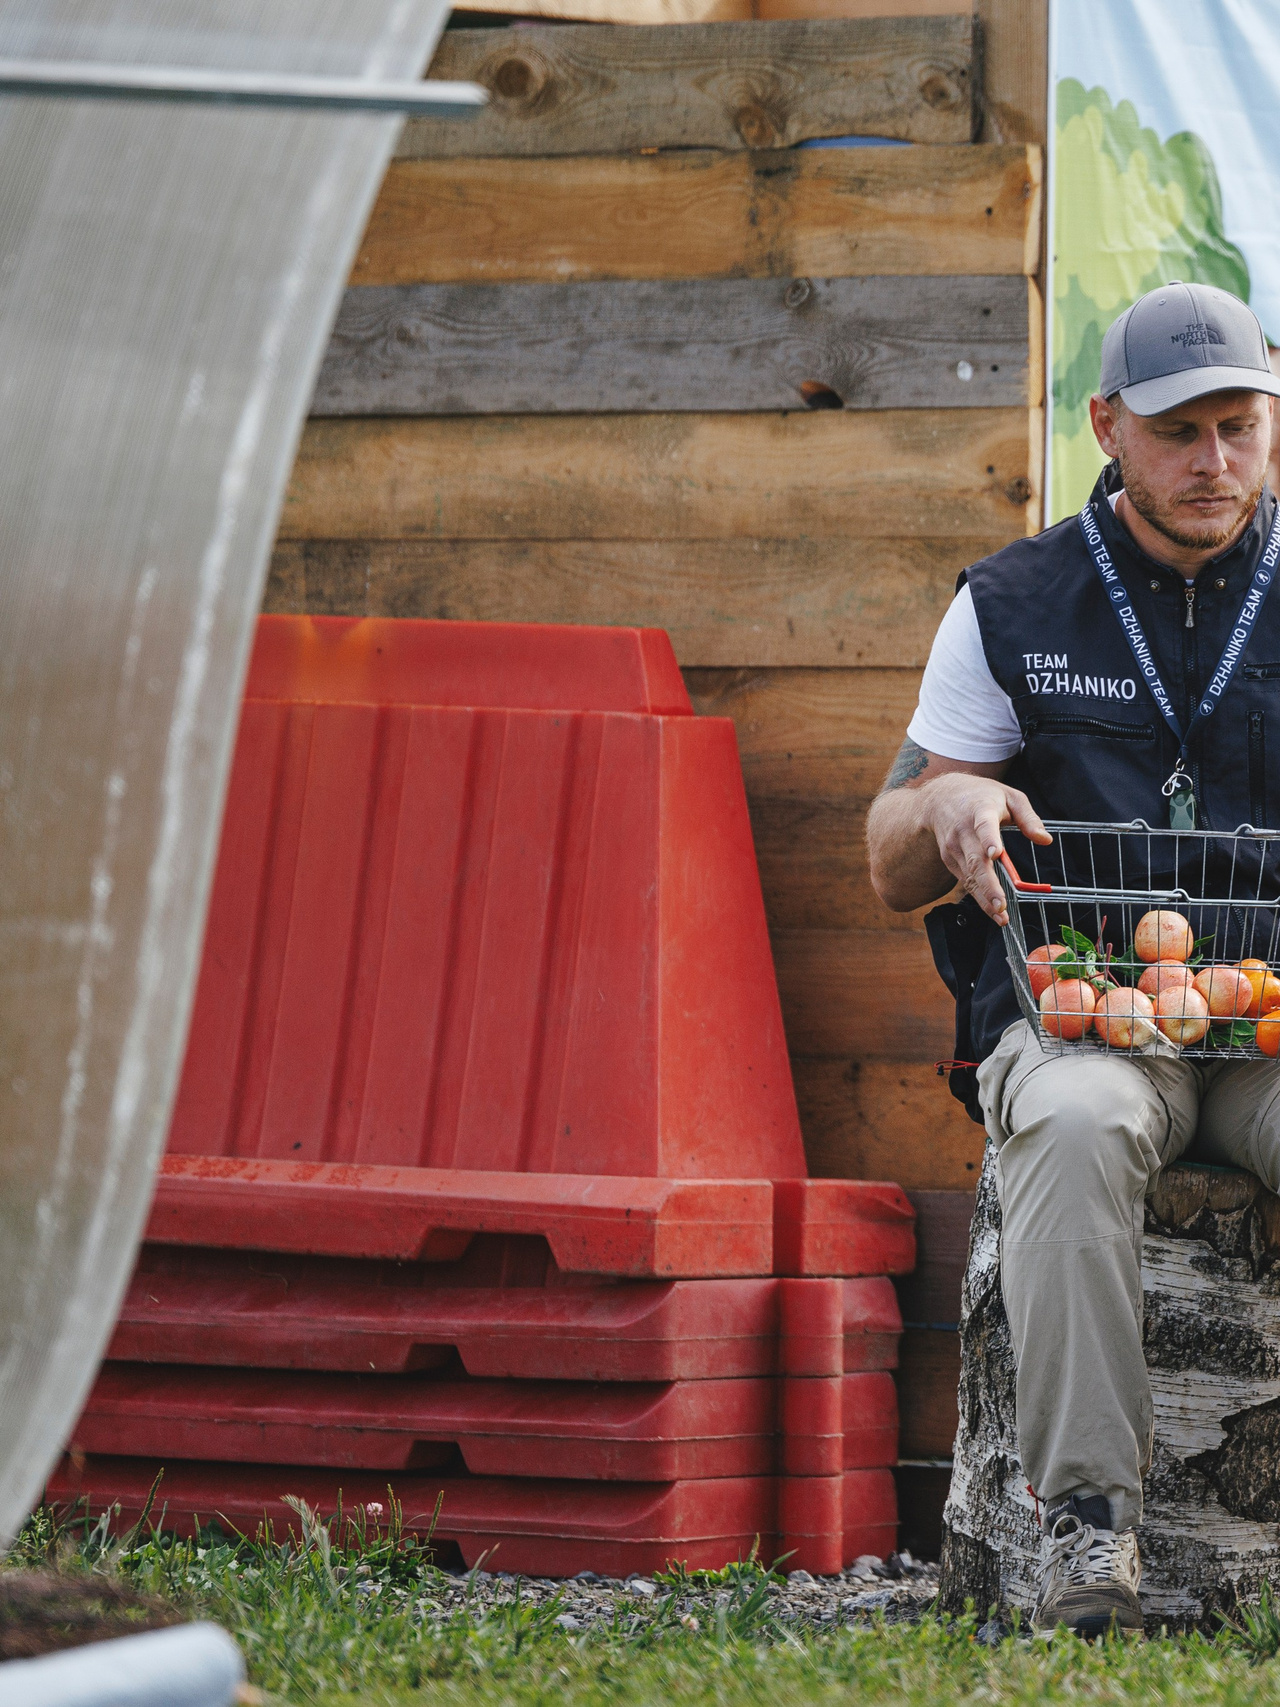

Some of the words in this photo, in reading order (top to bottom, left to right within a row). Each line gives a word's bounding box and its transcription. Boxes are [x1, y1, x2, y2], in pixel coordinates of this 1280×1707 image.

[1171, 330, 1208, 343] NORTH
[1182, 338, 1208, 348] FACE
[1081, 503, 1101, 545] ANIKO
[1094, 544, 1118, 582] TEAM
[1119, 606, 1156, 677] DZHANIKO
[1151, 679, 1174, 717] TEAM
[1209, 628, 1247, 696] DZHANIKO
[1238, 588, 1263, 626] TEAM
[1022, 653, 1068, 669] TEAM
[1025, 672, 1136, 700] DZHANIKO
